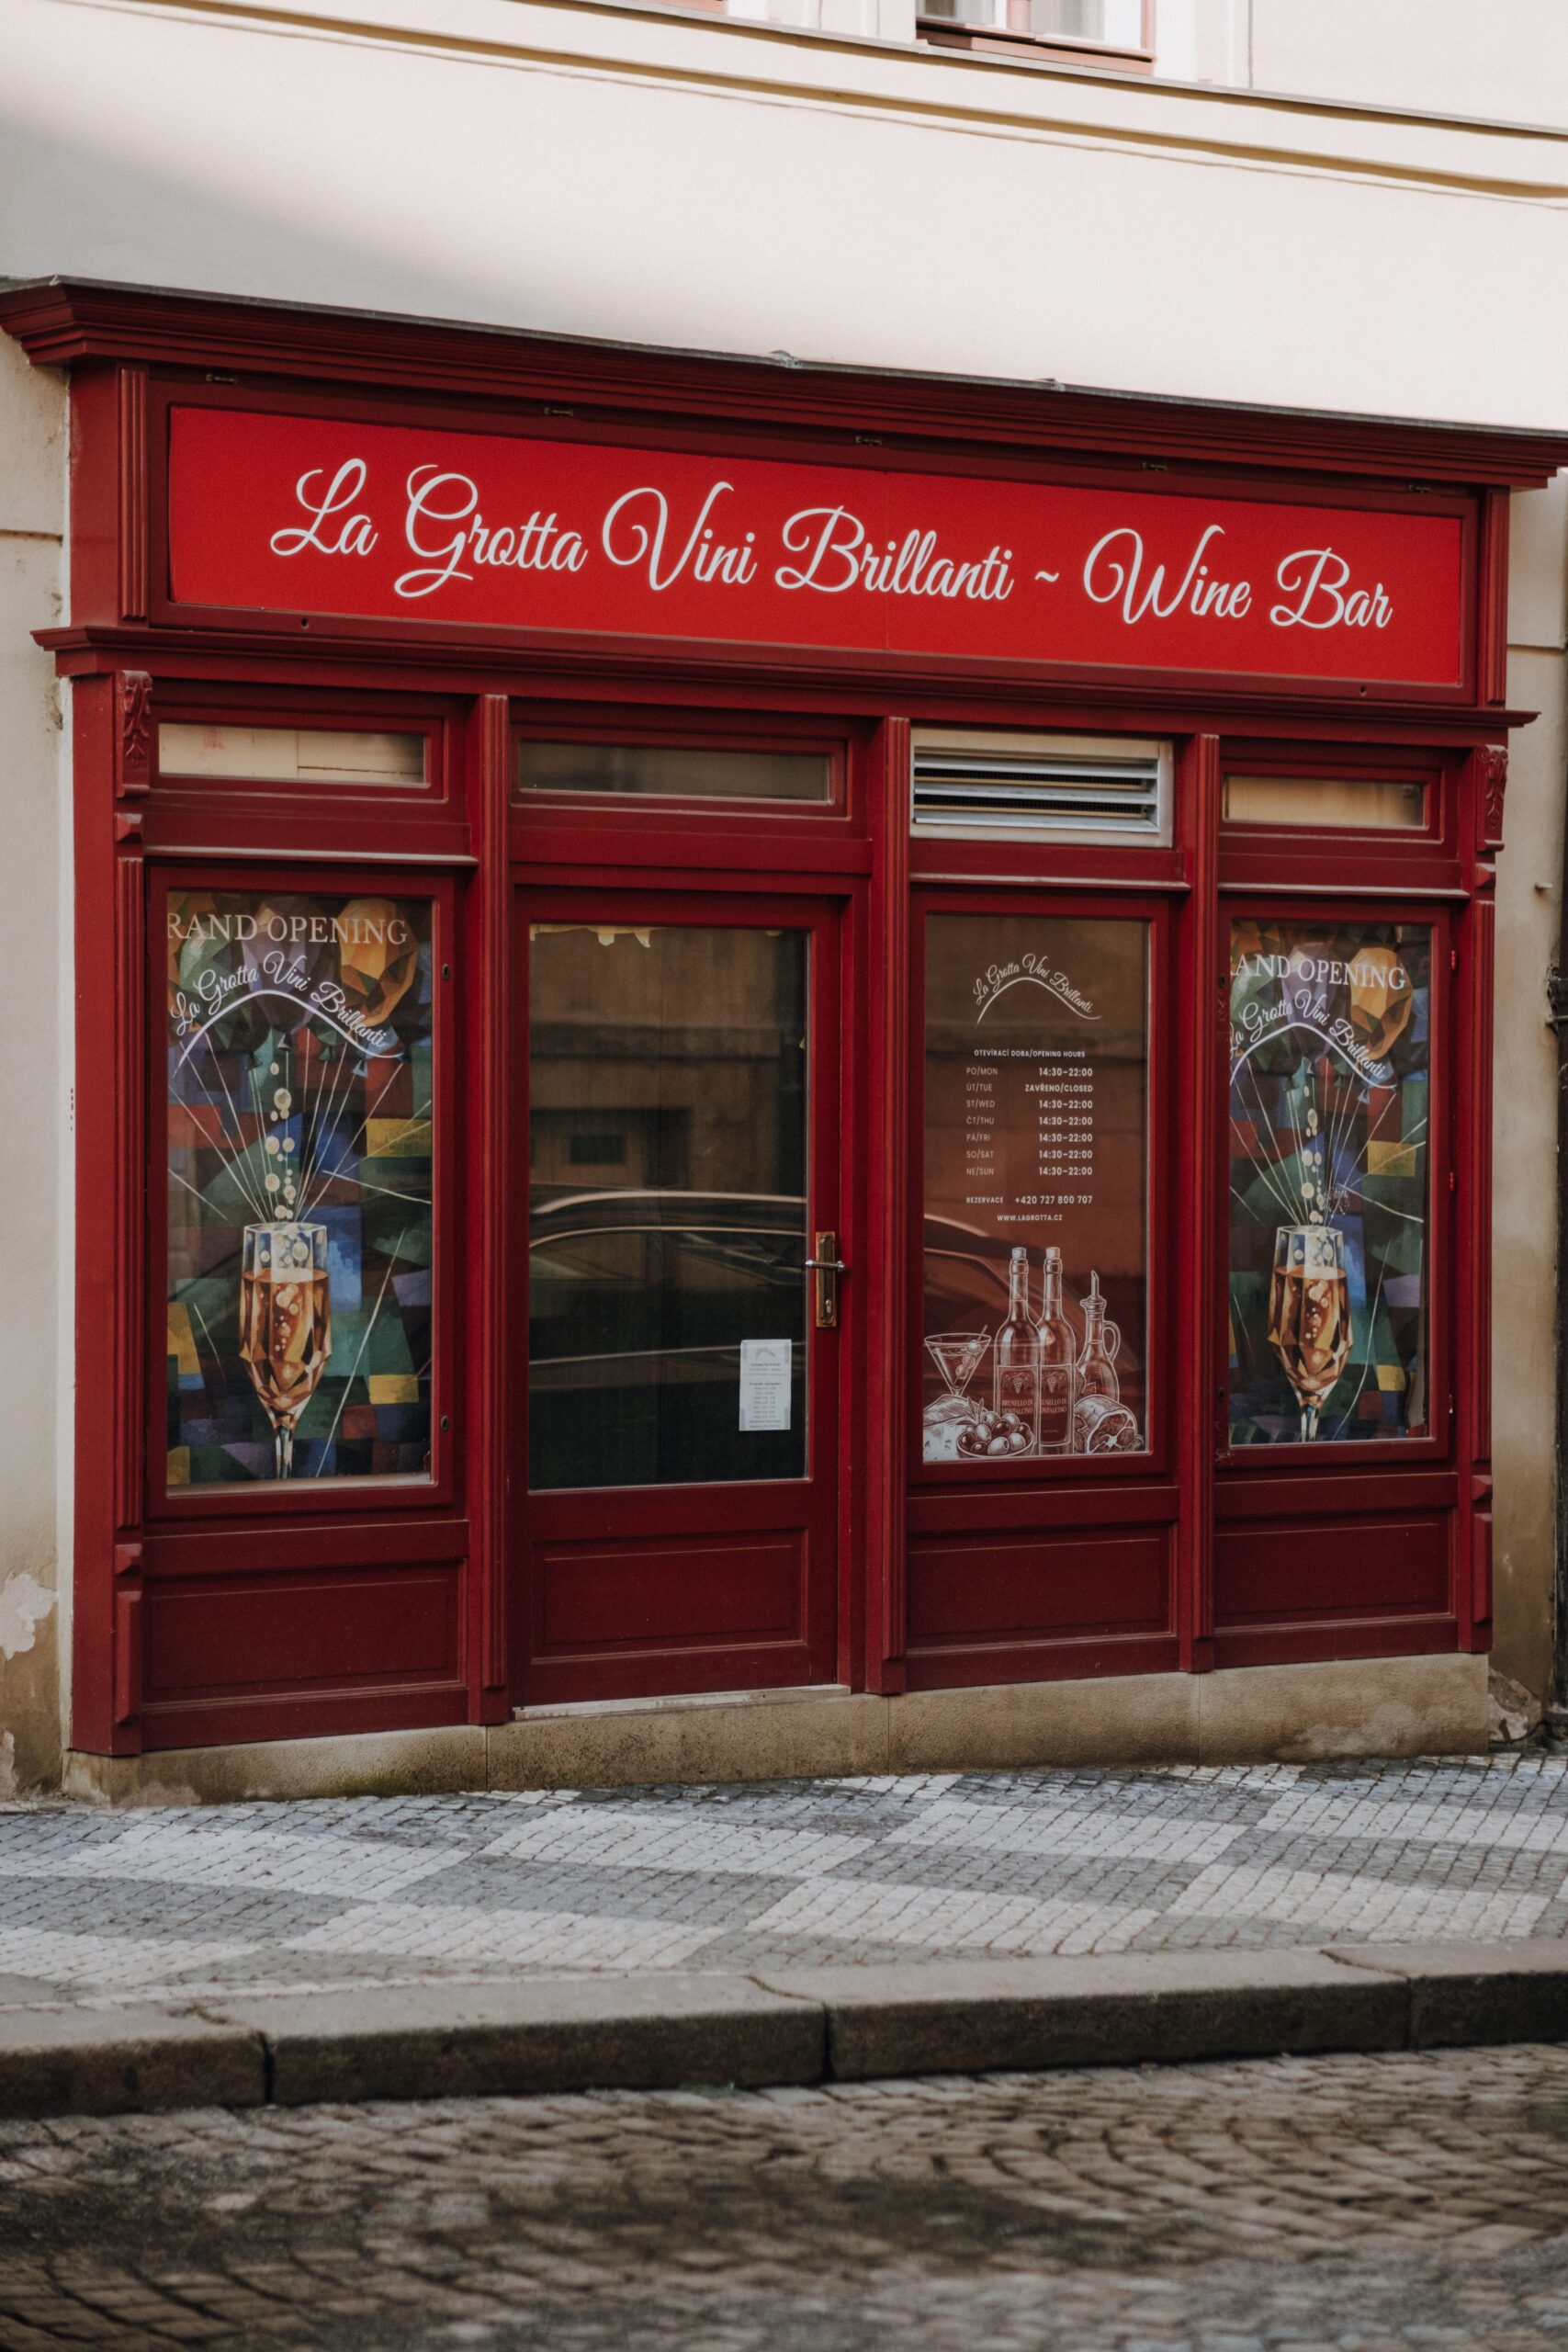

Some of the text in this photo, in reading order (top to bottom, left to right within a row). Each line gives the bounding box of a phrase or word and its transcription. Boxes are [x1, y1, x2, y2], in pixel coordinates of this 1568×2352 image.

[270, 458, 378, 556] La
[394, 464, 588, 598] Grotta
[602, 481, 757, 591] Vini
[774, 505, 1014, 600] Brillanti
[1083, 525, 1252, 624] Wine
[1269, 548, 1393, 628] Bar
[266, 915, 408, 945] OPENING
[1230, 955, 1405, 989] AND OPENING
[973, 953, 1093, 1012] La Grotta Vini Brillanti
[171, 951, 388, 1046] La Grotta Vini Brillanti
[1239, 1000, 1293, 1043] Grotta
[1294, 989, 1330, 1025] Vini
[1329, 1018, 1385, 1079] Brillanti
[974, 1048, 1010, 1057] OTEVÍRACÍ
[1011, 1049, 1061, 1058] DOBA/OPENING
[966, 1066, 998, 1076] PO/MON
[1025, 1082, 1093, 1093] ZAVŘENO/CLOSED
[966, 1099, 995, 1109] ST/WED
[966, 1115, 995, 1125] ČT/THU
[966, 1148, 995, 1159] SO/SAT
[966, 1166, 994, 1176] NE/SUN
[1015, 1195, 1037, 1204] +420
[1040, 1195, 1055, 1204] 727
[1057, 1195, 1075, 1204] 800
[1077, 1195, 1093, 1204] 707
[997, 1214, 1063, 1222] WWW.LAGROTTA.CZ
